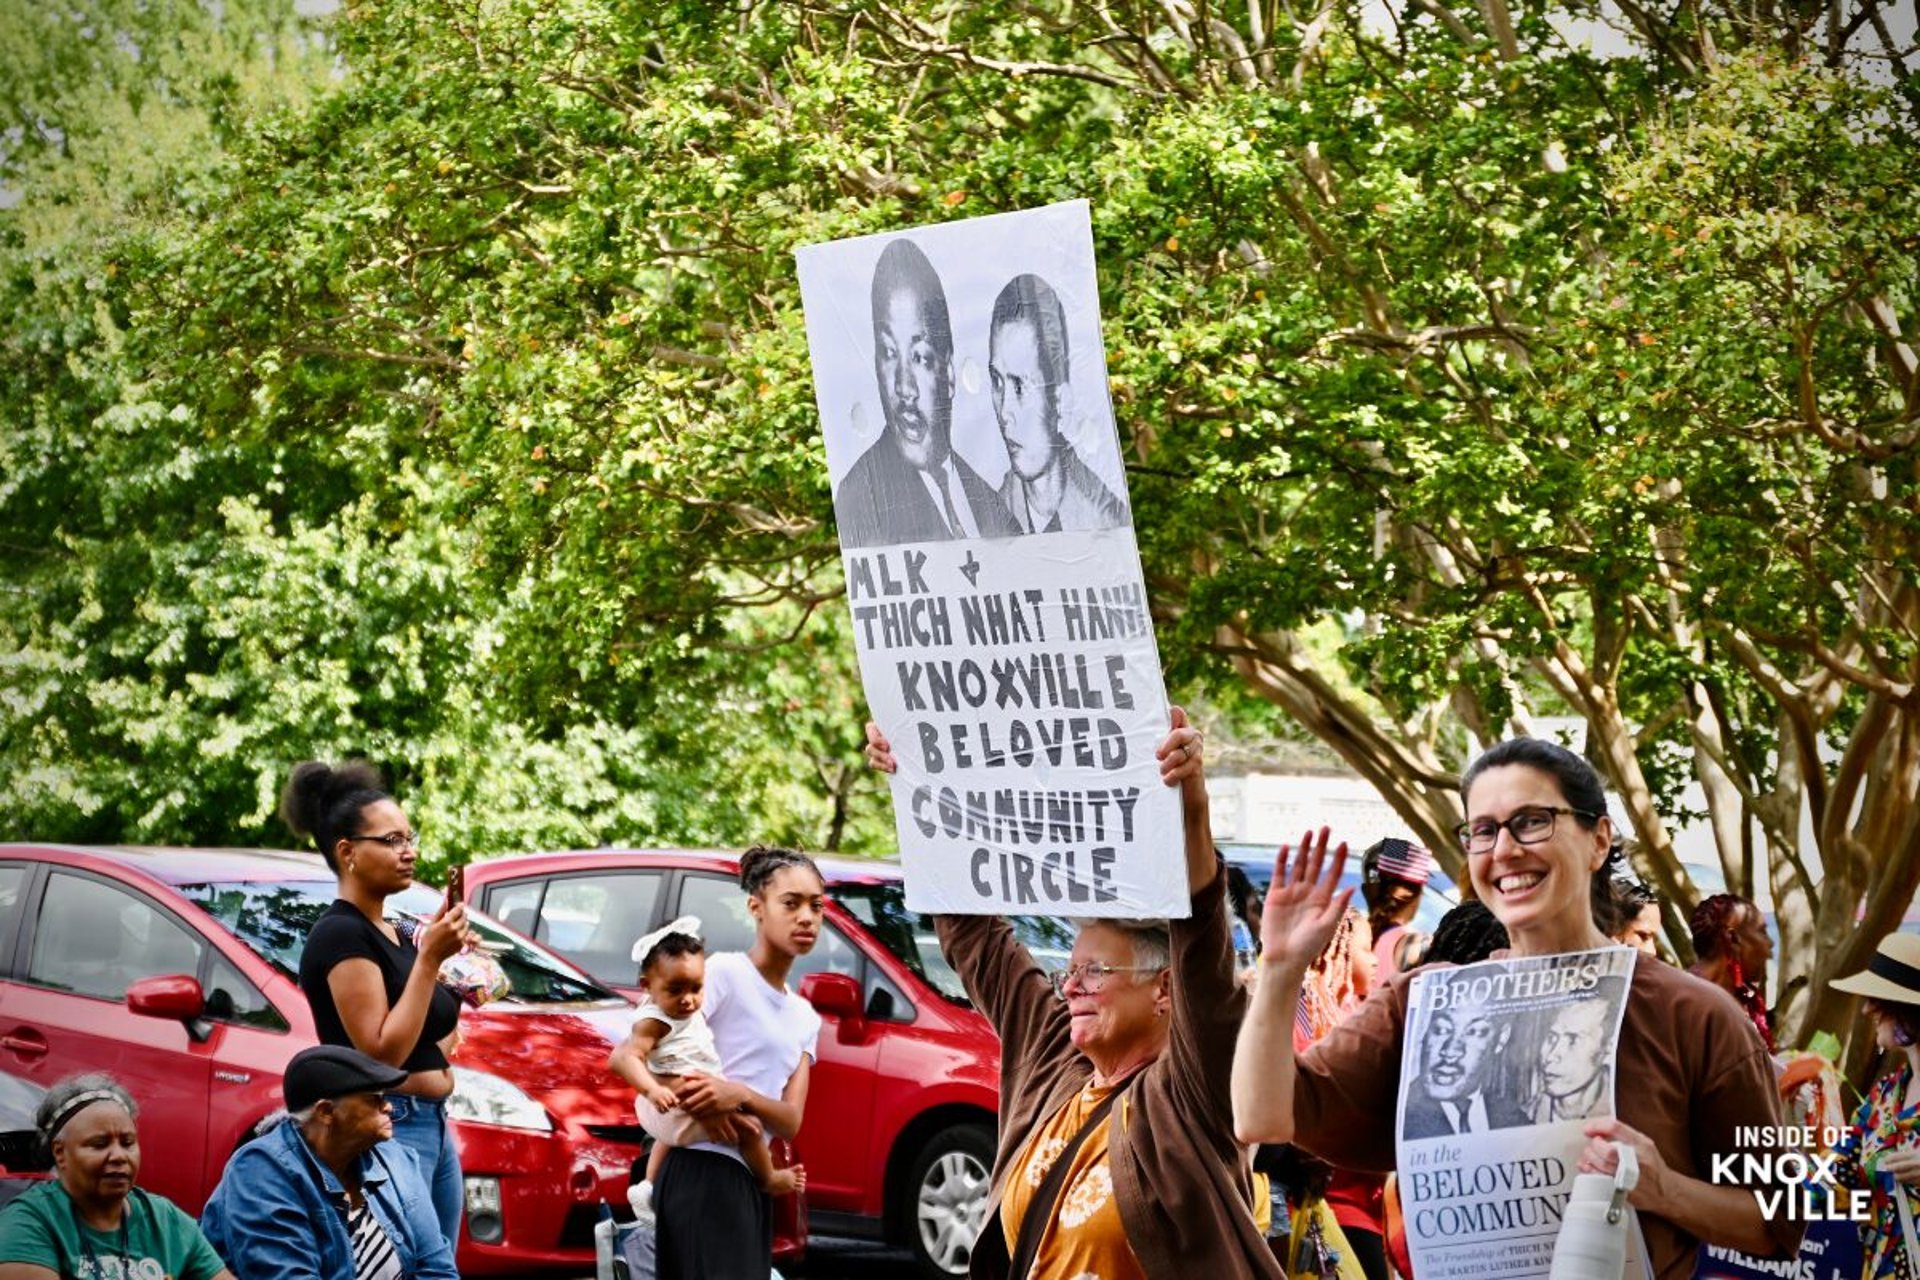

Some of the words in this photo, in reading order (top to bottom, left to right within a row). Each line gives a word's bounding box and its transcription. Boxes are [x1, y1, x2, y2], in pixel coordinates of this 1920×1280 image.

[850, 550, 930, 599] MLK
[854, 597, 952, 650] THICH
[958, 589, 1046, 646] NHAT
[896, 653, 1135, 712] KNOXVILLE
[917, 718, 1129, 774] BELOVED
[912, 785, 1140, 844] COMMUNITY
[971, 847, 1118, 904] CIRCLE
[1429, 964, 1600, 1011] BROTHERS
[1410, 1149, 1426, 1166] in
[1434, 1144, 1461, 1165] the
[1410, 1157, 1565, 1202] BELOVED
[1447, 1264, 1488, 1276] MARTIN
[1489, 1259, 1530, 1271] LUTHER
